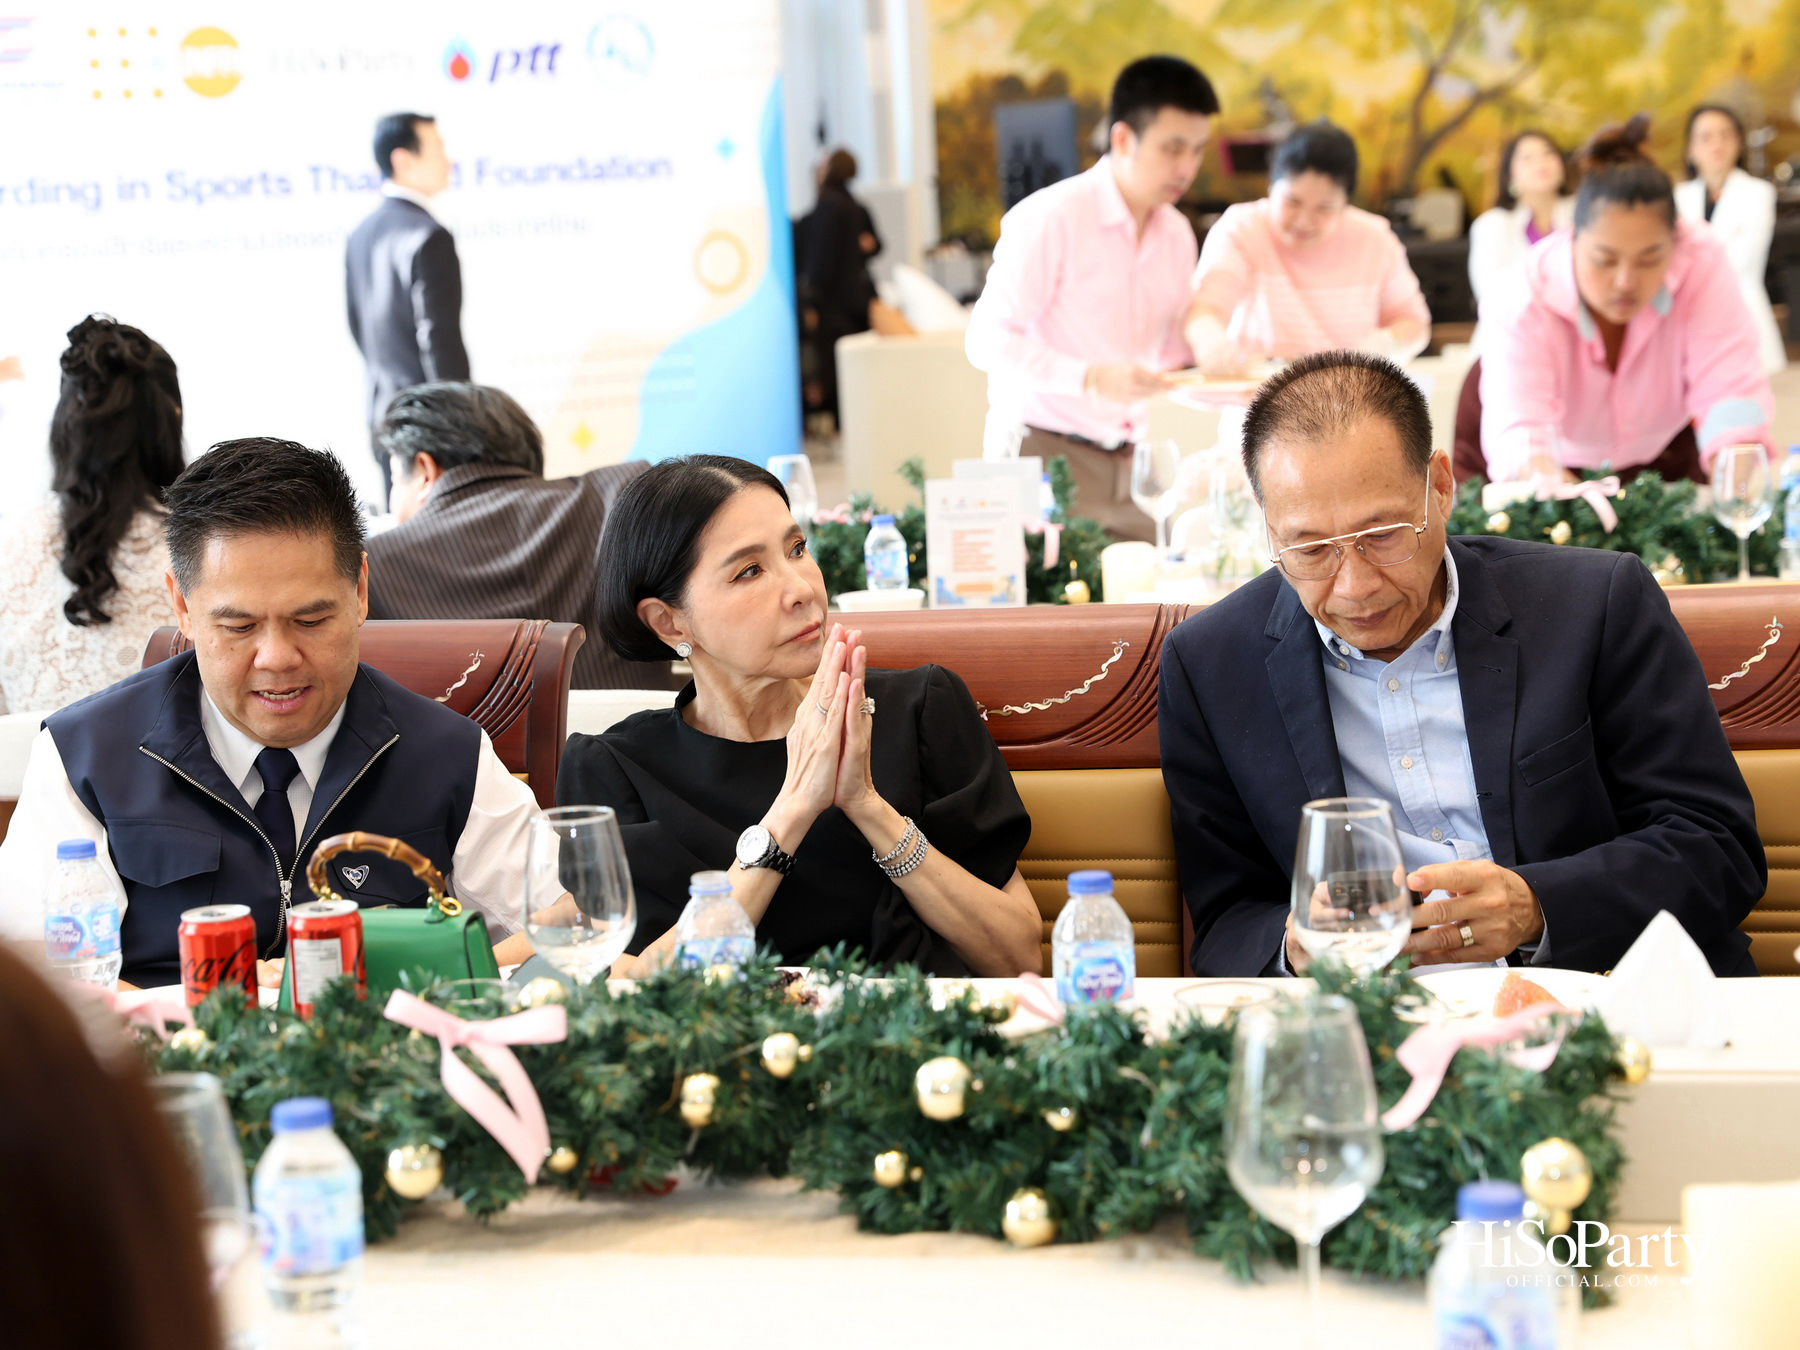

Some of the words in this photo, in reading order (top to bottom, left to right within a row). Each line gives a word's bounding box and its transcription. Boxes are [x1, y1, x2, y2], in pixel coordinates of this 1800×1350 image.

[489, 39, 562, 84] ptt
[116, 171, 151, 201] in
[165, 168, 294, 206] Sports
[475, 156, 673, 188] Foundation
